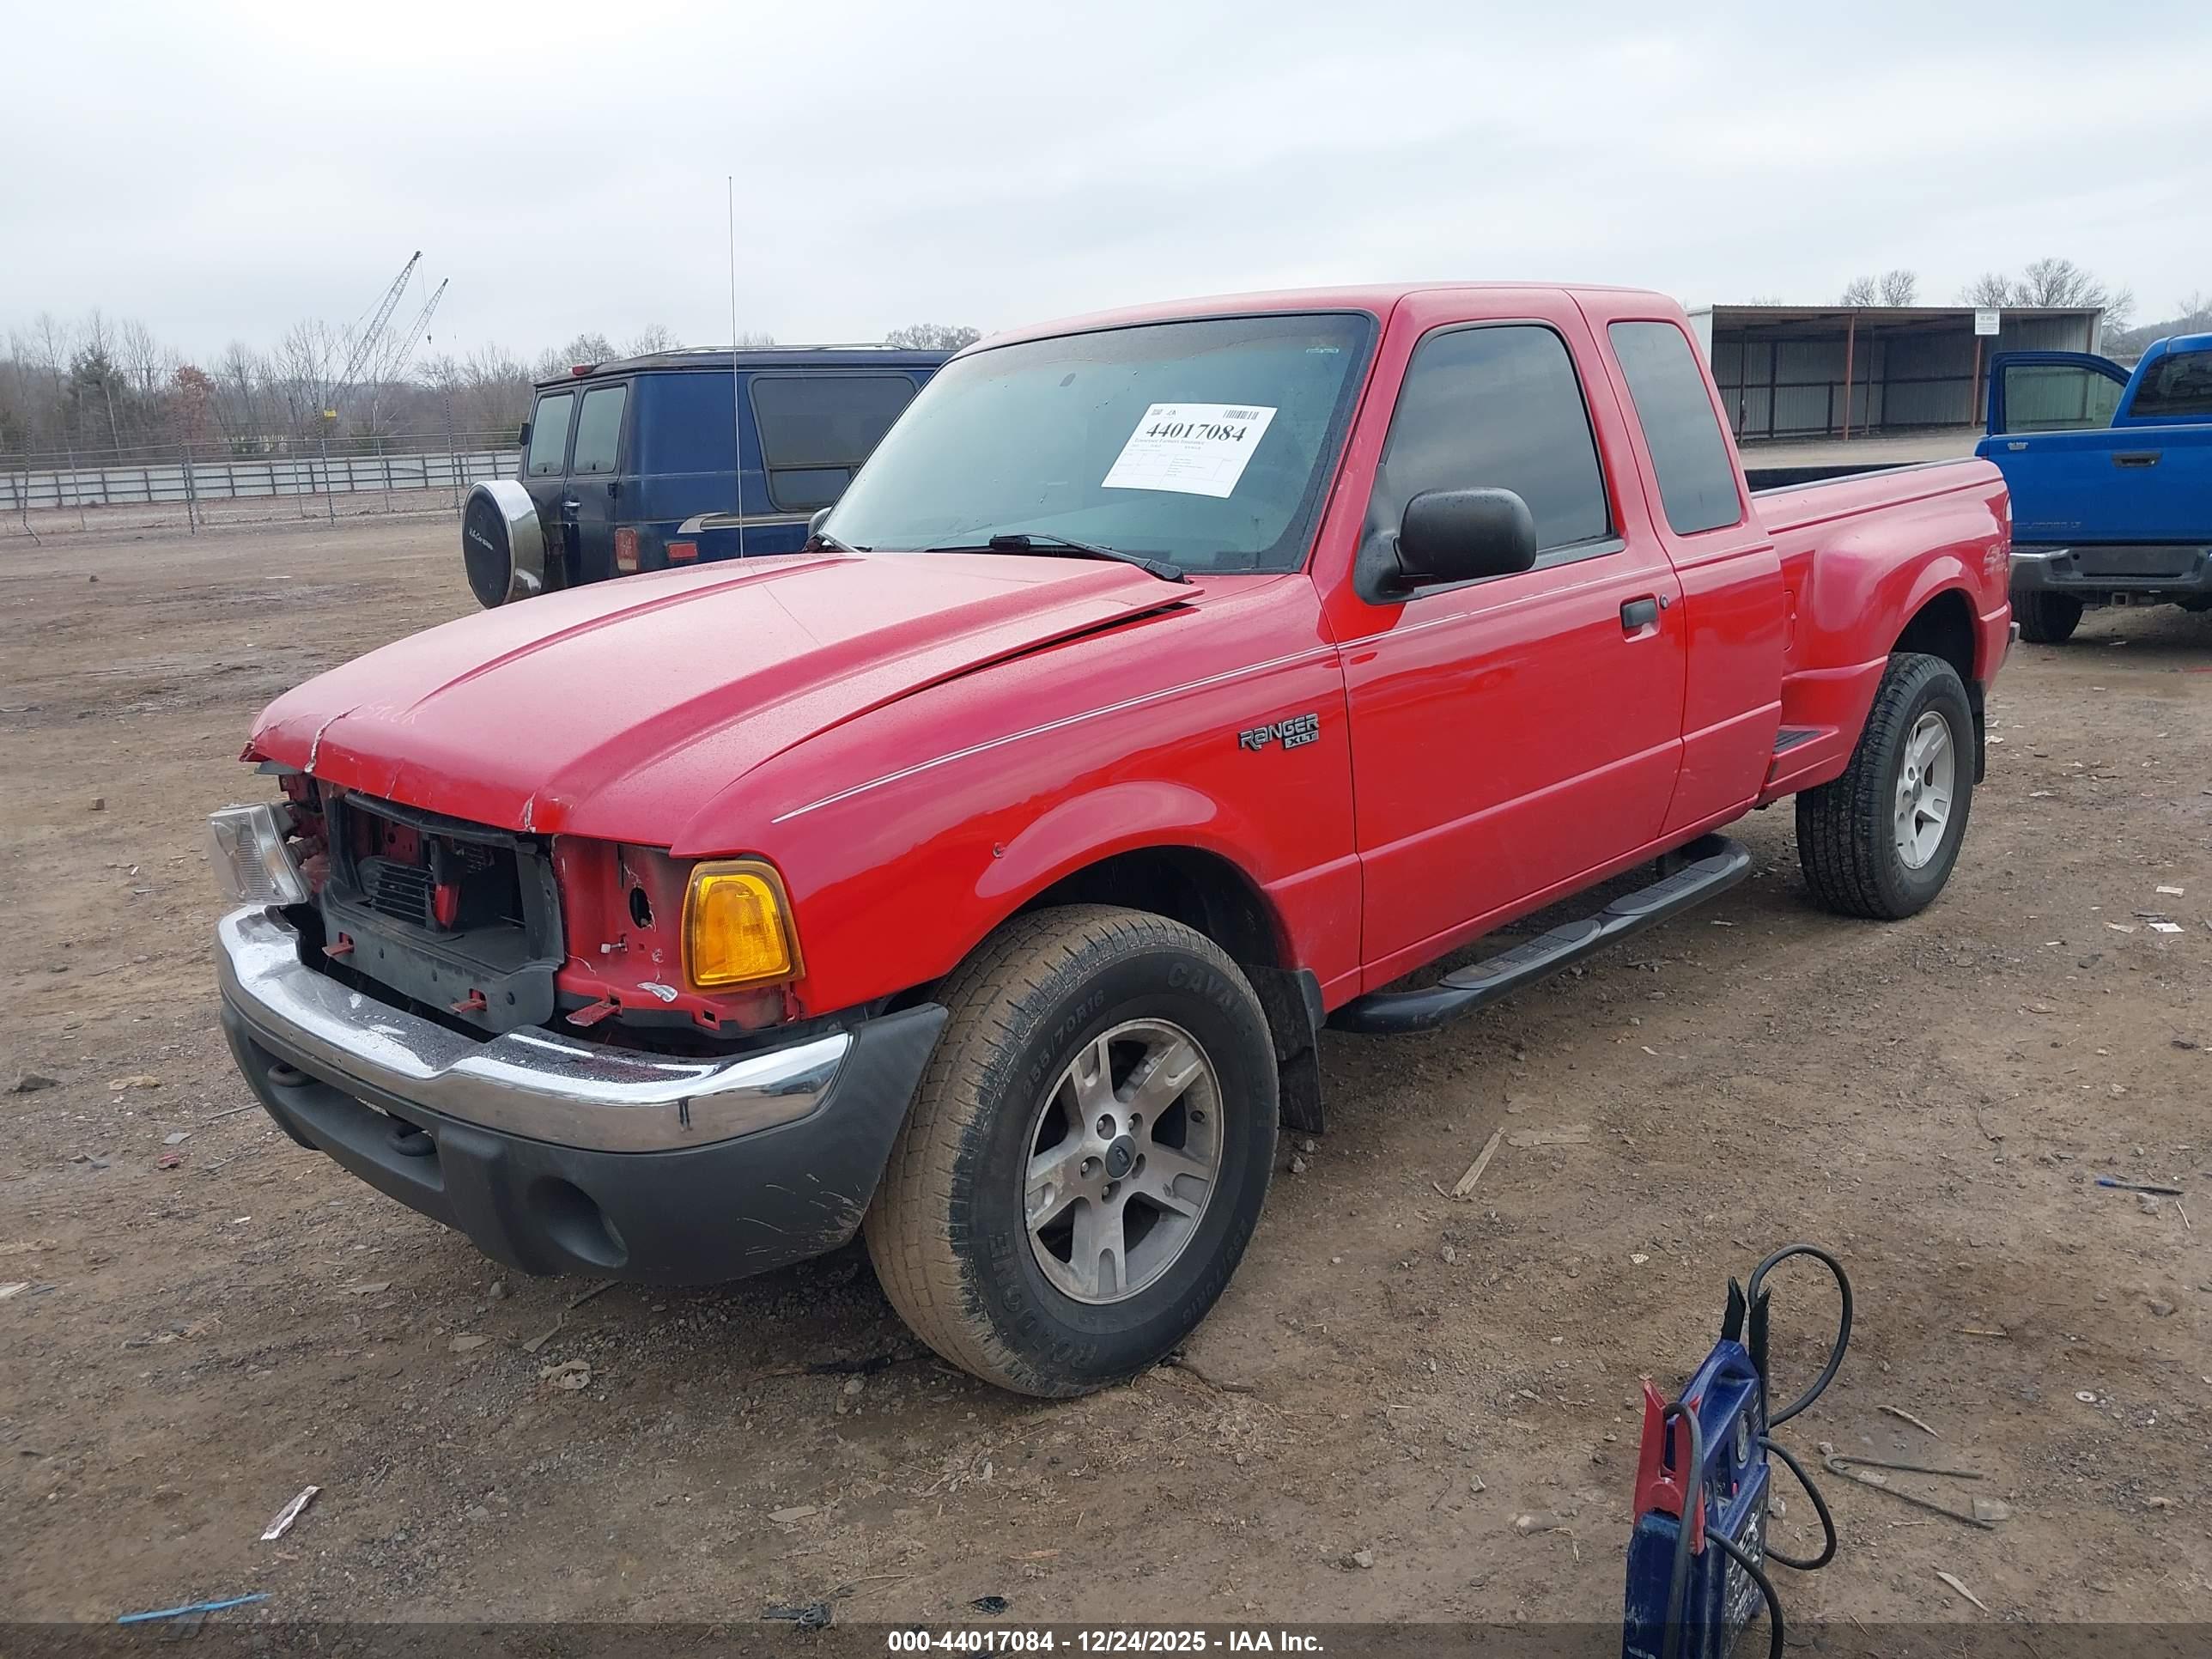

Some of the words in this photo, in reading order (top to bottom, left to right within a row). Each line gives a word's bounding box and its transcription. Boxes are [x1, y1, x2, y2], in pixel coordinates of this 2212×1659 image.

[1146, 422, 1247, 441] 44017084
[1239, 713, 1320, 750] RANGER
[1286, 731, 1317, 747] XLT
